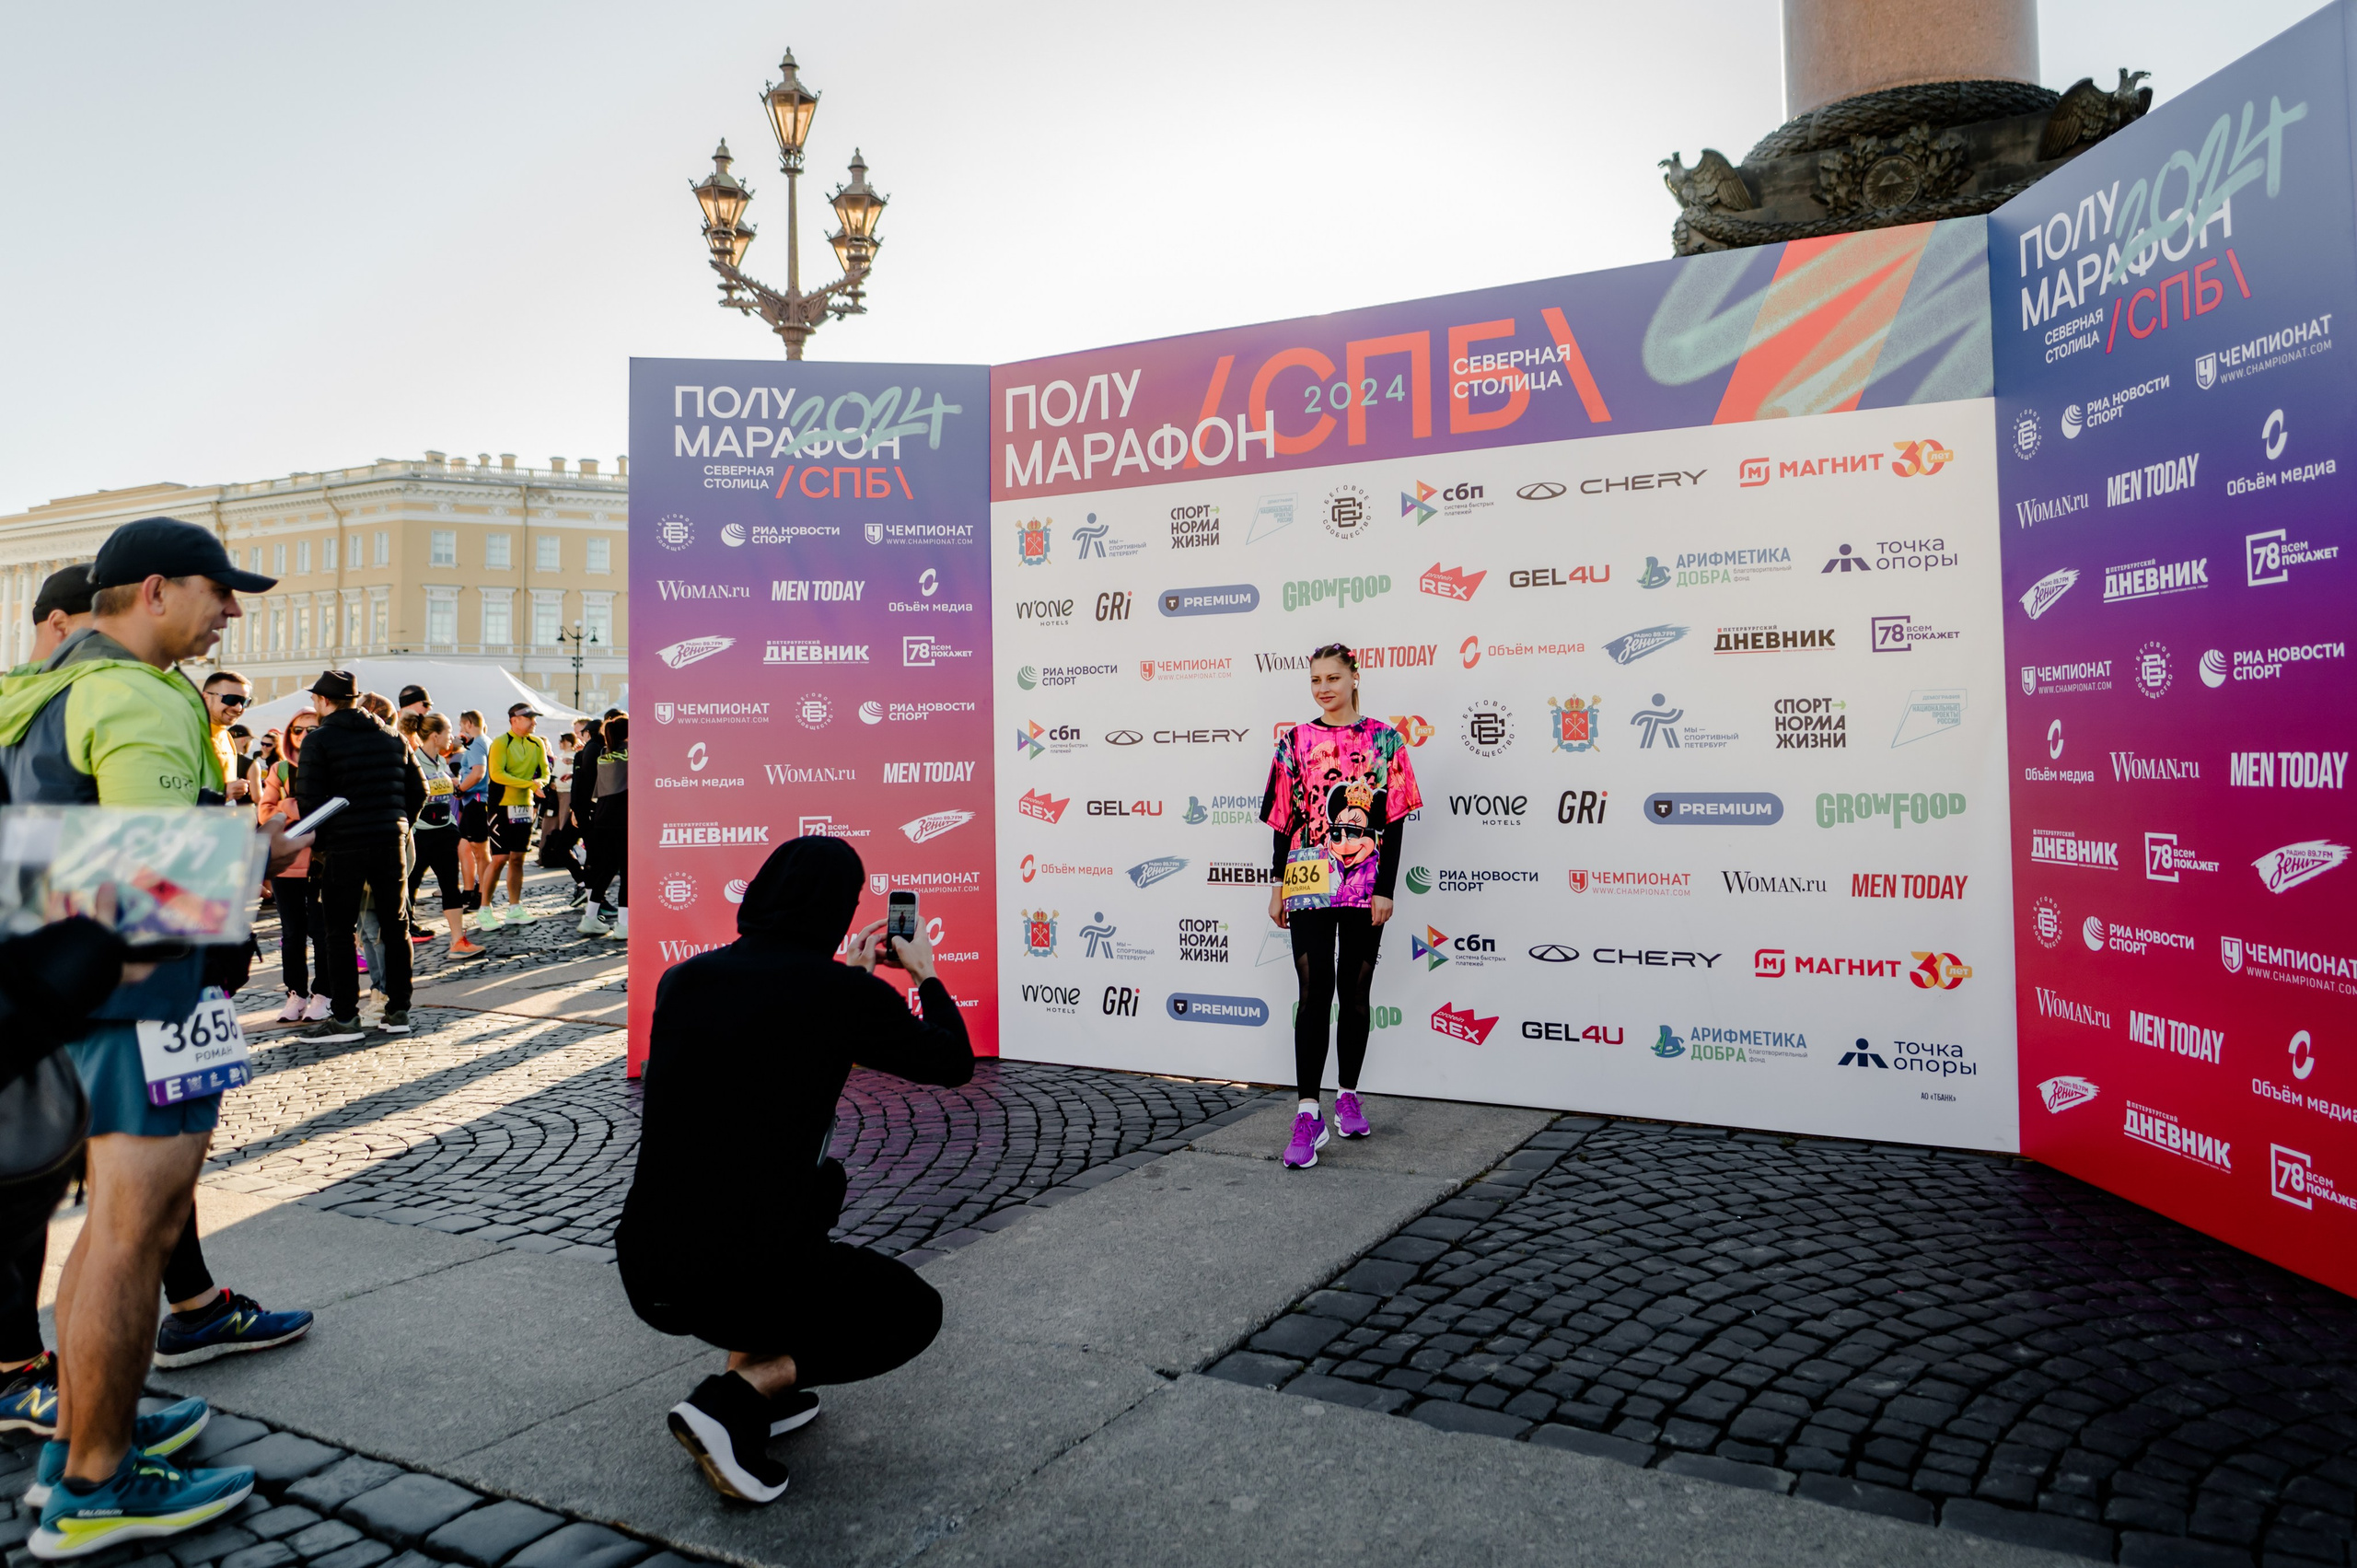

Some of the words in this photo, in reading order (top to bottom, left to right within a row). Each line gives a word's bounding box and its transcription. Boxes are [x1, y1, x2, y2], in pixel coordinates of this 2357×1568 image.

[2110, 95, 2308, 285] 2024
[2019, 180, 2119, 278] ПОЛУ
[2021, 189, 2232, 331] МАРАФОН
[2044, 308, 2104, 346] СЕВЕРНАЯ
[2045, 330, 2099, 364] СТОЛИЦА
[2219, 314, 2332, 368] ЧЕМПИОНАТ
[1453, 343, 1571, 376] СЕВЕРНАЯ
[2220, 340, 2332, 384] WWW.CHAMPIONAT.COM
[1303, 375, 1406, 413] 2024
[1453, 371, 1563, 400] СТОЛИЦА
[2086, 398, 2110, 415] РИА
[2112, 375, 2170, 408] НОВОСТИ
[674, 386, 796, 420] ПОЛУ
[1004, 369, 1142, 432] ПОЛУ
[784, 386, 962, 456] 2024
[674, 425, 900, 459] МАРАФОН
[1004, 410, 1275, 488] МАРАФОН
[1780, 453, 1884, 478] МАГНИТ
[1891, 439, 1946, 478] 30
[1931, 450, 1950, 460] лет
[704, 465, 773, 476] СЕВЕРНАЯ
[2107, 469, 2142, 507] MEN
[2144, 453, 2199, 497] TODAY
[2227, 472, 2276, 495] Объём
[2282, 459, 2336, 483] медиа
[704, 479, 769, 490] СТОЛИЦА
[1581, 470, 1707, 494] CHERY
[1443, 483, 1483, 501] сбп
[1171, 505, 1210, 520] СПОРТ
[752, 526, 777, 536] РИА
[782, 527, 840, 535] НОВОСТИ
[887, 525, 973, 536] ЧЕМПИОНАТ
[1170, 518, 1220, 535] НОРМА
[752, 535, 793, 543] СПОРТ
[1172, 533, 1219, 549] ЖИЗНИ
[1876, 539, 1944, 553] точка
[1677, 547, 1791, 570] АРИФМЕТИКА
[1876, 553, 1957, 571] опоры
[2253, 542, 2280, 575] 78
[2281, 547, 2339, 566] ПОКАЖЕТ
[1426, 572, 1453, 582] protein
[1510, 565, 1609, 587] GEL4U
[1677, 569, 1731, 587] ДОБРА
[1734, 565, 1792, 574] благотворительный
[2104, 558, 2208, 598] ДНЕВНИК
[772, 581, 809, 600] MEN
[812, 581, 865, 600] TODAY
[1422, 578, 1468, 599] REX
[889, 601, 929, 611] Объём
[933, 604, 972, 612] медиа
[1184, 594, 1250, 607] PREMIUM
[1714, 629, 1835, 651] ДНЕВНИК
[1879, 624, 1904, 645] 78
[1907, 632, 1959, 640] ПОКАЖЕТ
[1388, 645, 1437, 667] TODAY
[1488, 644, 1534, 656] Объём
[1539, 643, 1585, 655] медиа
[2234, 650, 2264, 665] РИА
[2268, 643, 2344, 662] НОВОСТИ
[1043, 668, 1063, 676] РИА
[1067, 665, 1117, 675] НОВОСТИ
[1042, 677, 1076, 686] СПОРТ
[2038, 681, 2111, 694] WWW.CHAMPIONAT.COM
[678, 703, 770, 714] ЧЕМПИОНАТ
[888, 712, 929, 720] СПОРТ
[889, 703, 914, 712] РИА
[918, 703, 974, 711] НОВОСТИ
[1462, 700, 1513, 719] БЕГОВОЕ
[1912, 704, 1958, 713] НАЦИОНАЛЬНЫЕ
[1775, 715, 1845, 731] НОРМА
[1050, 726, 1080, 740] сбп
[1154, 729, 1249, 743] CHERY
[1776, 733, 1846, 749] ЖИЗНИ
[1461, 733, 1515, 758] СООБЩЕСТВО
[884, 762, 920, 783] MEN
[923, 761, 975, 782] TODAY
[2231, 752, 2274, 786] MEN
[2278, 752, 2348, 788] TODAY
[656, 777, 698, 787] Объём
[702, 778, 744, 788] медиа
[1087, 801, 1162, 816] GEL4U
[1212, 811, 1252, 825] ДОБРА
[1679, 804, 1771, 815] PREMIUM
[828, 829, 870, 837] ПОКАЖЕТ
[2031, 837, 2119, 866] ДНЕВНИК
[2151, 844, 2172, 870] 78
[1041, 864, 1074, 874] Объём
[1079, 866, 1112, 876] медиа
[2174, 859, 2219, 872] ПОКАЖЕТ
[1285, 865, 1319, 886] 4636
[1440, 870, 1467, 880] РИА
[1472, 871, 1538, 881] НОВОСТИ
[1592, 872, 1690, 885] ЧЕМПИОНАТ
[1439, 881, 1483, 891] СПОРТ
[1593, 888, 1690, 896] WWW.CHAMPIONAT.COM
[1852, 874, 1897, 898] MEN
[1901, 875, 1968, 900] TODAY
[1179, 934, 1227, 947] НОРМА
[1180, 948, 1228, 962] ЖИЗНИ
[1594, 948, 1722, 968] CHERY
[1795, 957, 1901, 977] МАГНИТ
[1909, 951, 1964, 990] 30
[1949, 966, 1968, 976] лет
[1192, 1003, 1260, 1017] PREMIUM
[1437, 1011, 1465, 1023] protein
[1434, 1016, 1480, 1044] REX
[1522, 1021, 1623, 1044] GEL4U
[1690, 1027, 1807, 1049] АРИФМЕТИКА
[2130, 1010, 2165, 1049] MEN
[195, 1046, 233, 1063] РОМАН
[1691, 1044, 1747, 1062] ДОБРА
[1748, 1048, 1808, 1060] благотворительный
[1894, 1041, 1962, 1057] точка
[1894, 1058, 1976, 1077] опоры
[2124, 1109, 2231, 1168] ДНЕВНИК
[2278, 1159, 2305, 1192] 78
